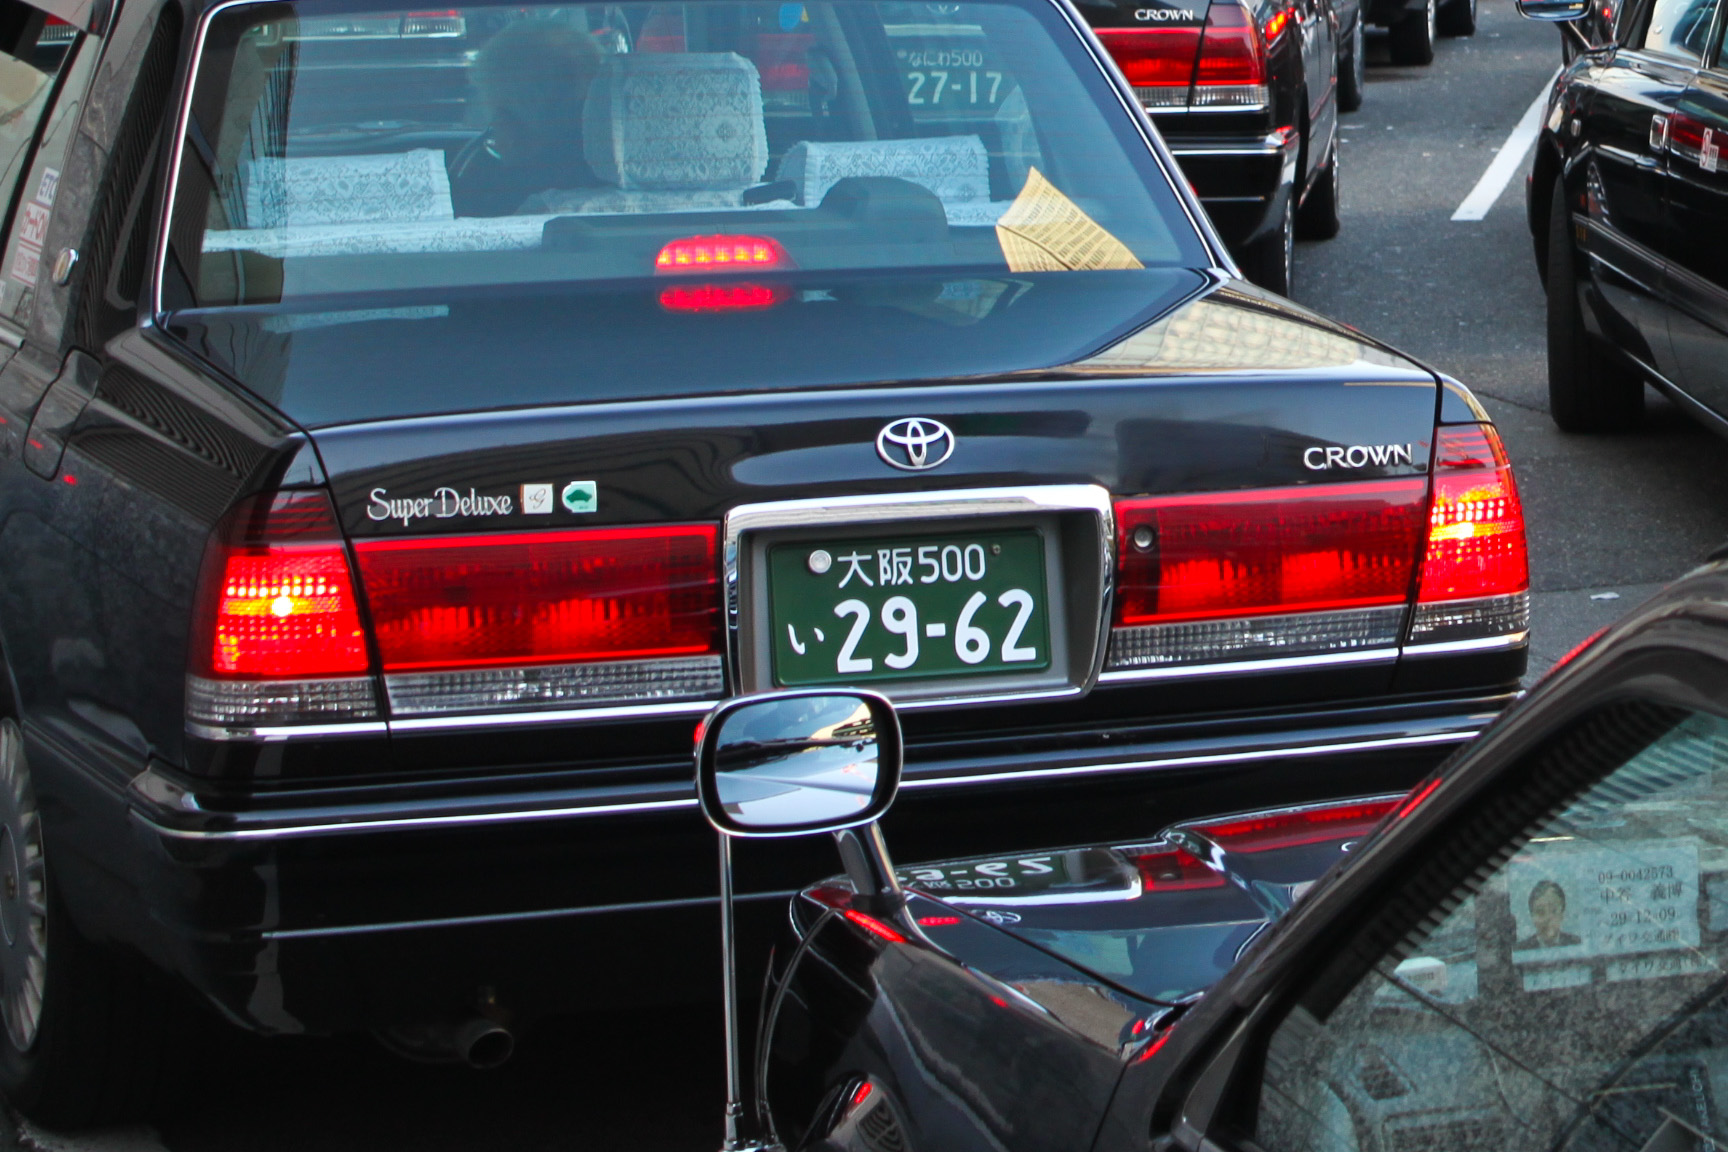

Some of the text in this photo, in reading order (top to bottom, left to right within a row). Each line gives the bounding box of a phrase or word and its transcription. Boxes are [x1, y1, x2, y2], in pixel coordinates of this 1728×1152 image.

[1134, 9, 1194, 22] CROWN
[951, 51, 983, 67] 500
[908, 72, 1002, 104] 27-17
[1303, 443, 1412, 470] CROWN
[367, 487, 433, 527] Super
[434, 486, 513, 519] Deluxe
[837, 543, 986, 589] 大阪 500
[787, 588, 1037, 674] い 29-62
